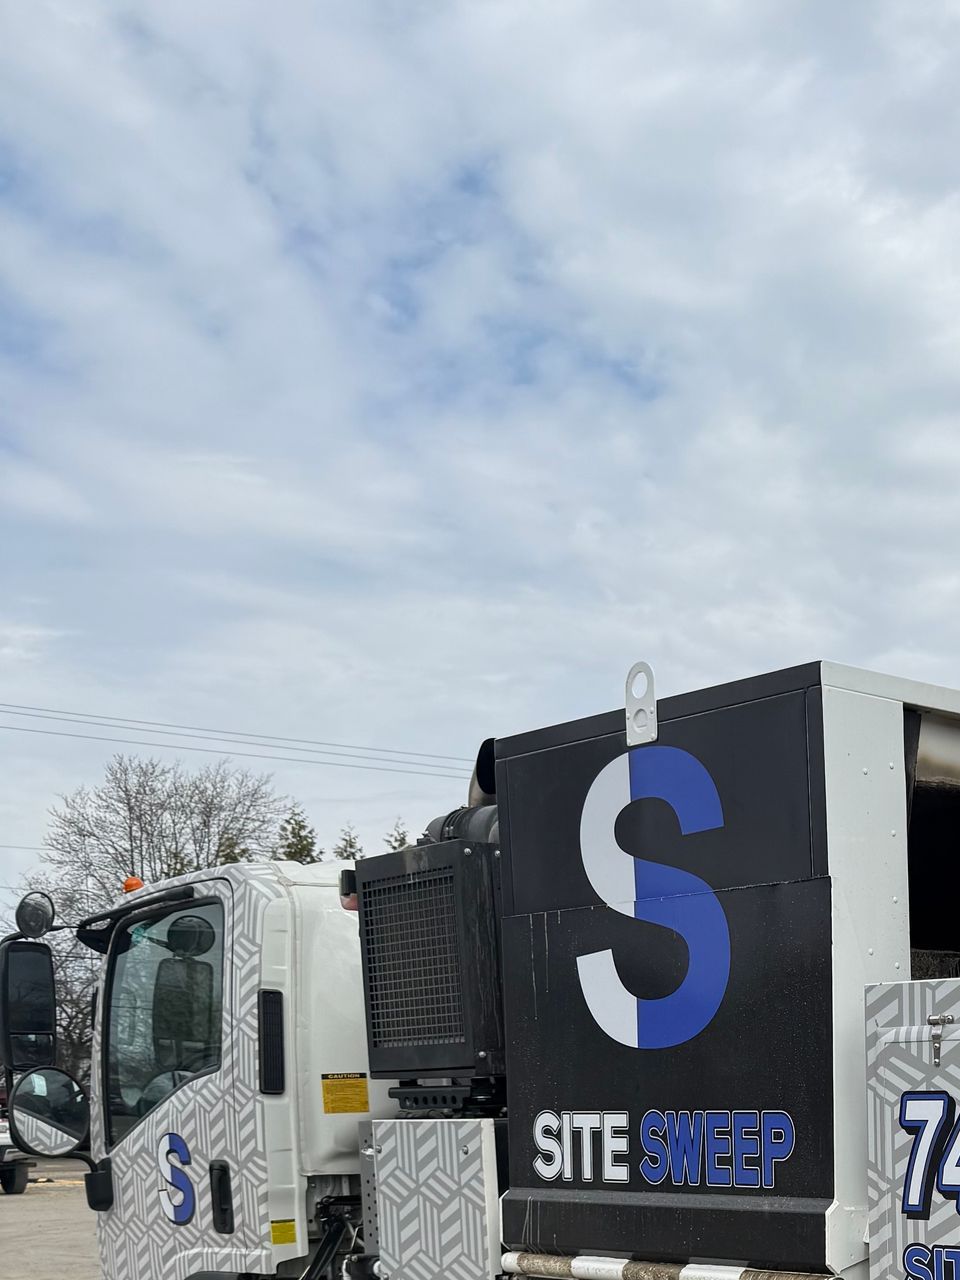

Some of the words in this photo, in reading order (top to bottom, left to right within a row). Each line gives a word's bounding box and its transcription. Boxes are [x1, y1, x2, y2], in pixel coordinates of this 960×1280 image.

[576, 745, 731, 1050] S
[158, 1132, 196, 1225] S
[532, 1109, 630, 1184] SITE
[640, 1109, 796, 1189] SWEEP
